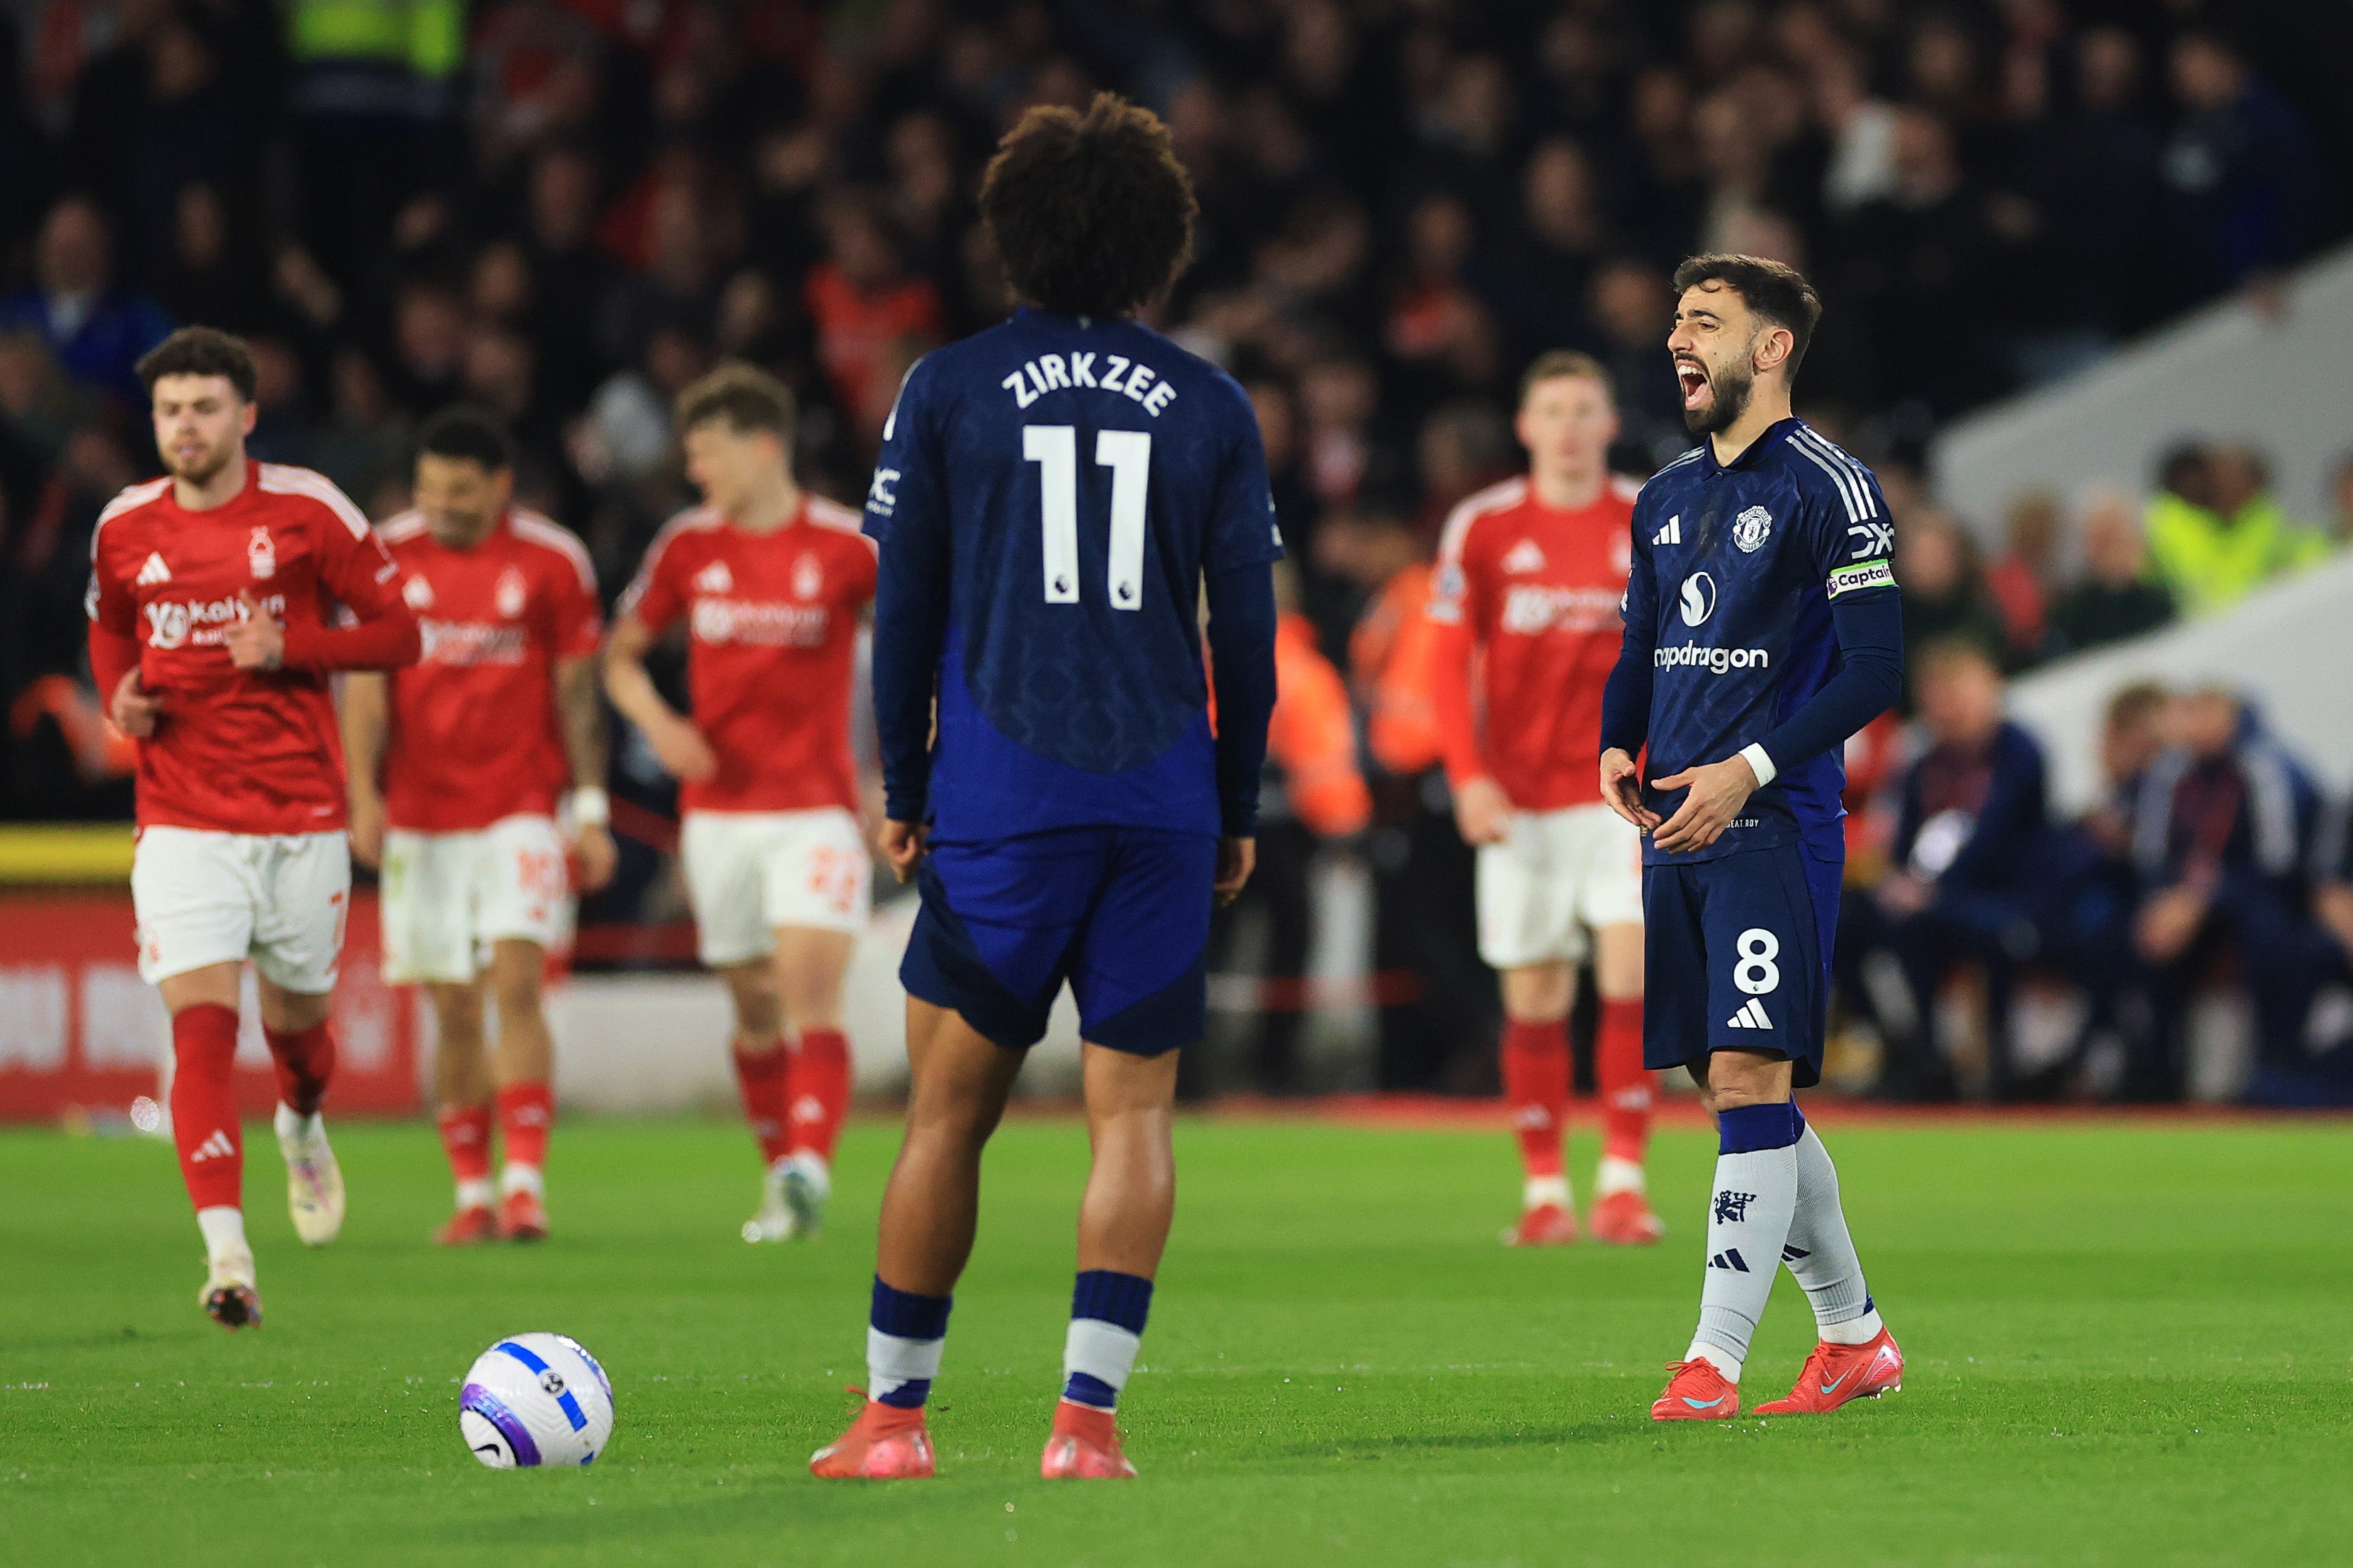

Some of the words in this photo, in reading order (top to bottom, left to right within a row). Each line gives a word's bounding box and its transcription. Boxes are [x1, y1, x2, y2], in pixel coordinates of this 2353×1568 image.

[1002, 351, 1177, 417] ZIRKZEE
[1022, 425, 1151, 611] 11
[1654, 639, 1769, 674] napdragon
[1733, 928, 1779, 995] 8
